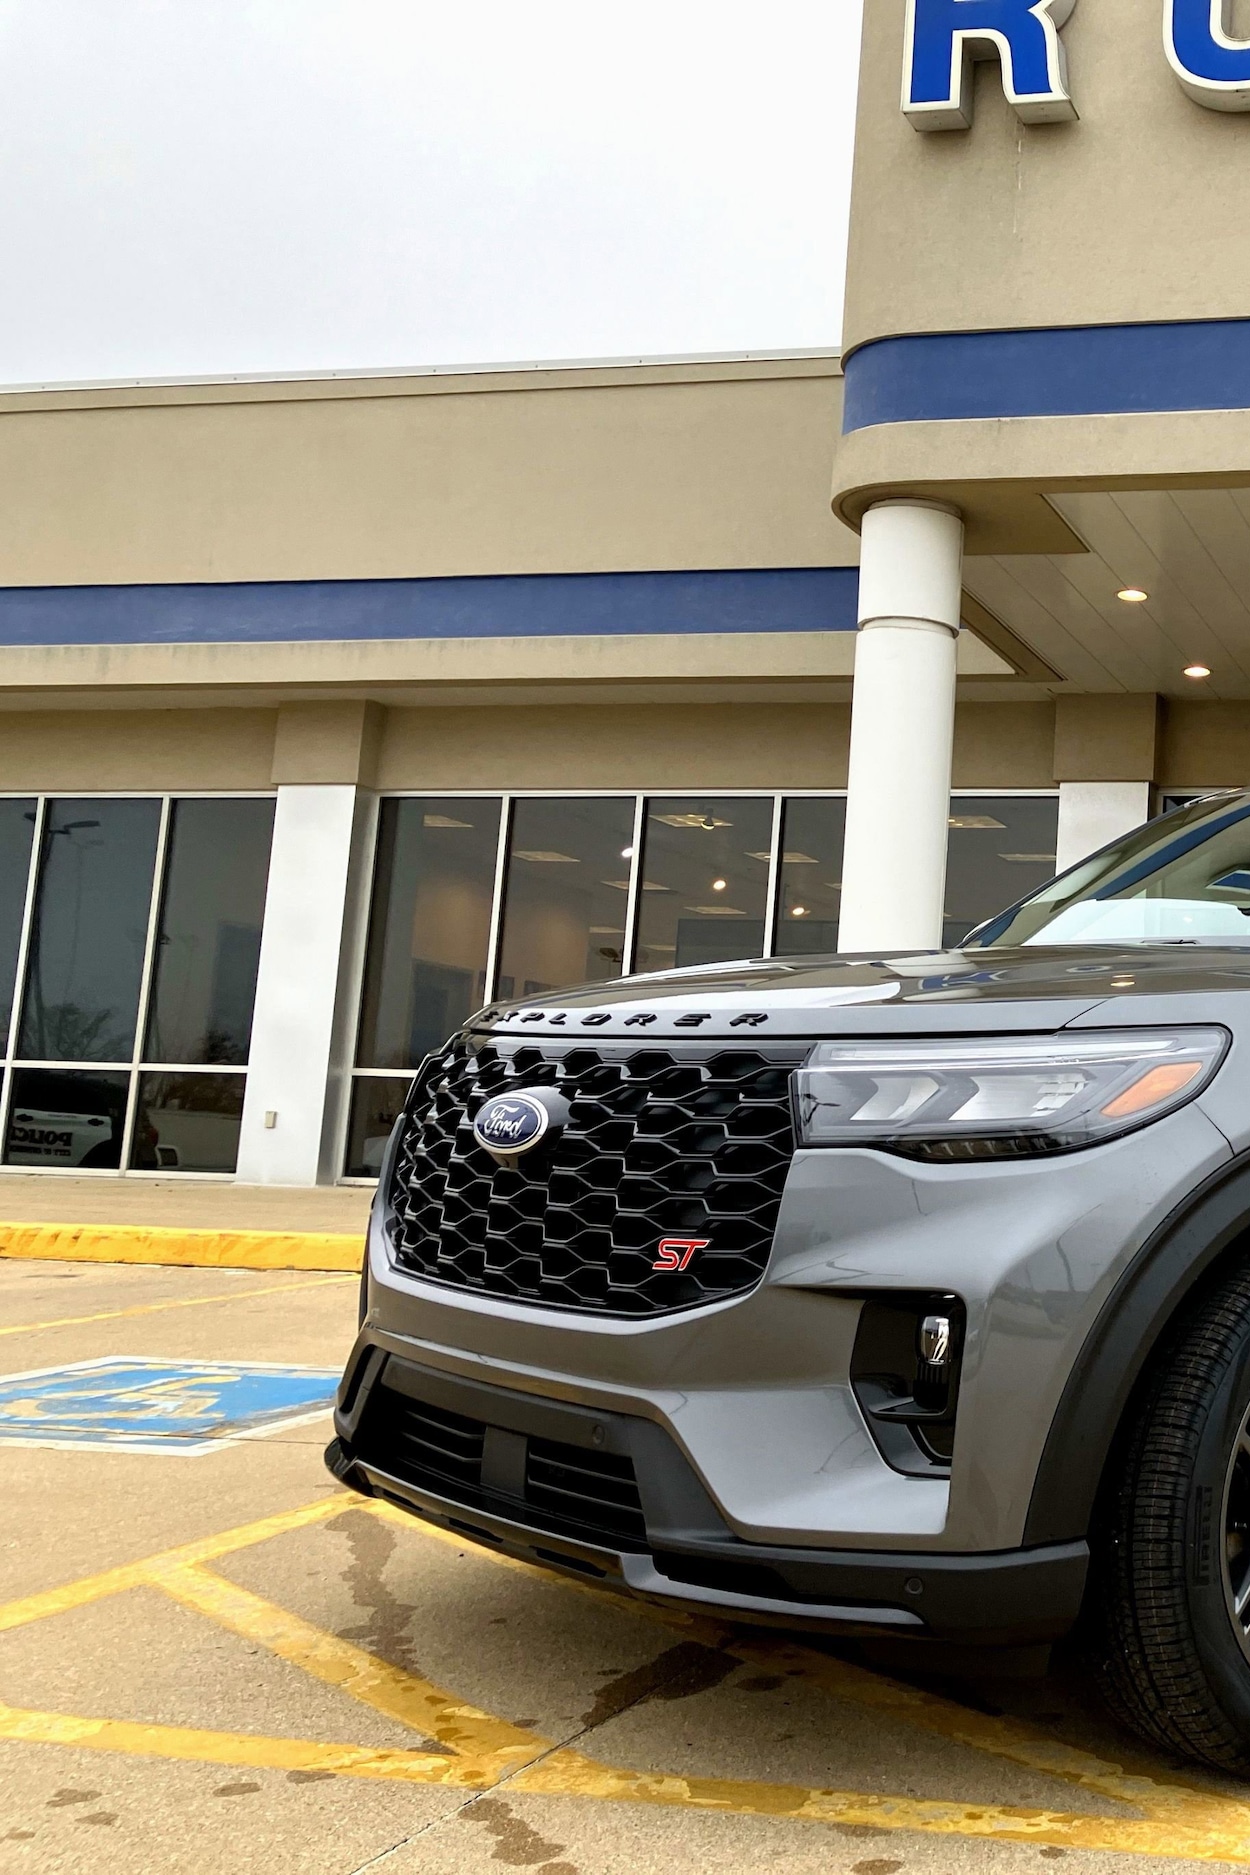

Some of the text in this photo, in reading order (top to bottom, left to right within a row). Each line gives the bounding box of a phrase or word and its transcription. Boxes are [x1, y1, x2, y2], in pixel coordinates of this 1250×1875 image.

[478, 1010, 769, 1027] EXPLORER
[483, 1104, 523, 1138] Ford
[652, 1238, 712, 1271] ST
